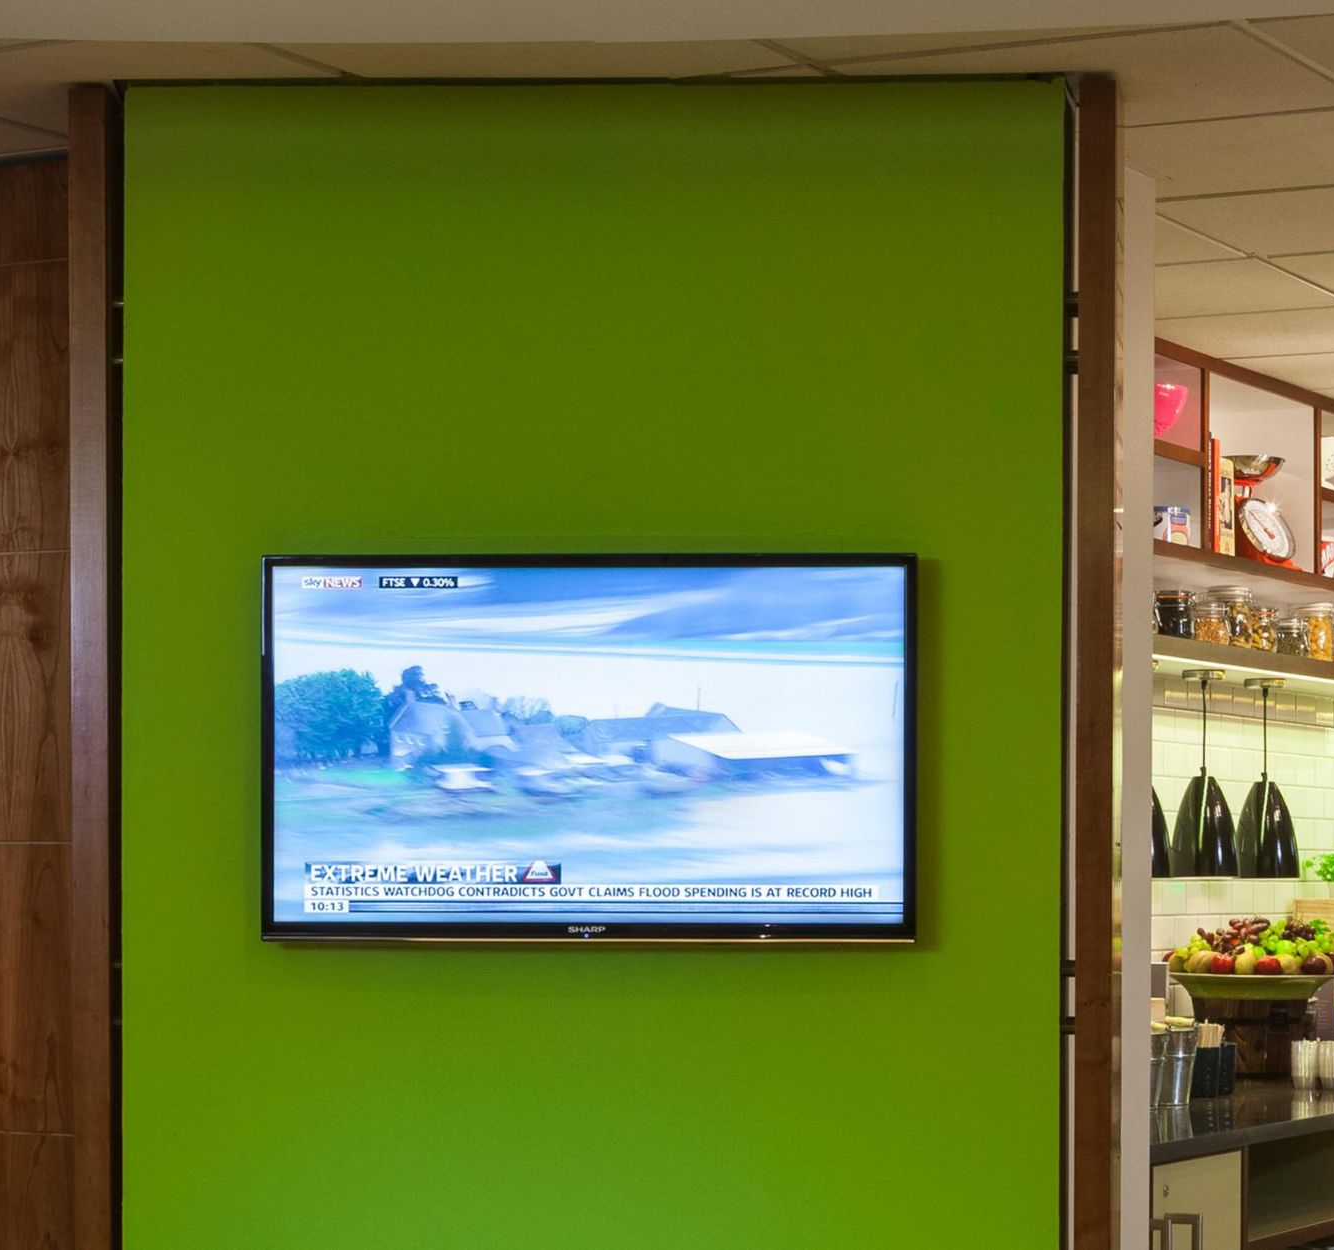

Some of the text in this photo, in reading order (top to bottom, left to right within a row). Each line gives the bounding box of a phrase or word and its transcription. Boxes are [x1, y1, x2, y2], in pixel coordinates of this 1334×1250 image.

[303, 576, 362, 589] sky NEWS
[382, 577, 455, 588] FTSE 0.30%
[310, 864, 518, 883] EXTREME WEATHER
[310, 886, 873, 898] STATISTICS WATCHDOG CONTRADICTS GOVT CLAIMS FLOOD SPENDING IS AT RECORD HIGH
[311, 902, 345, 911] 10:13
[567, 925, 606, 933] SHARP
